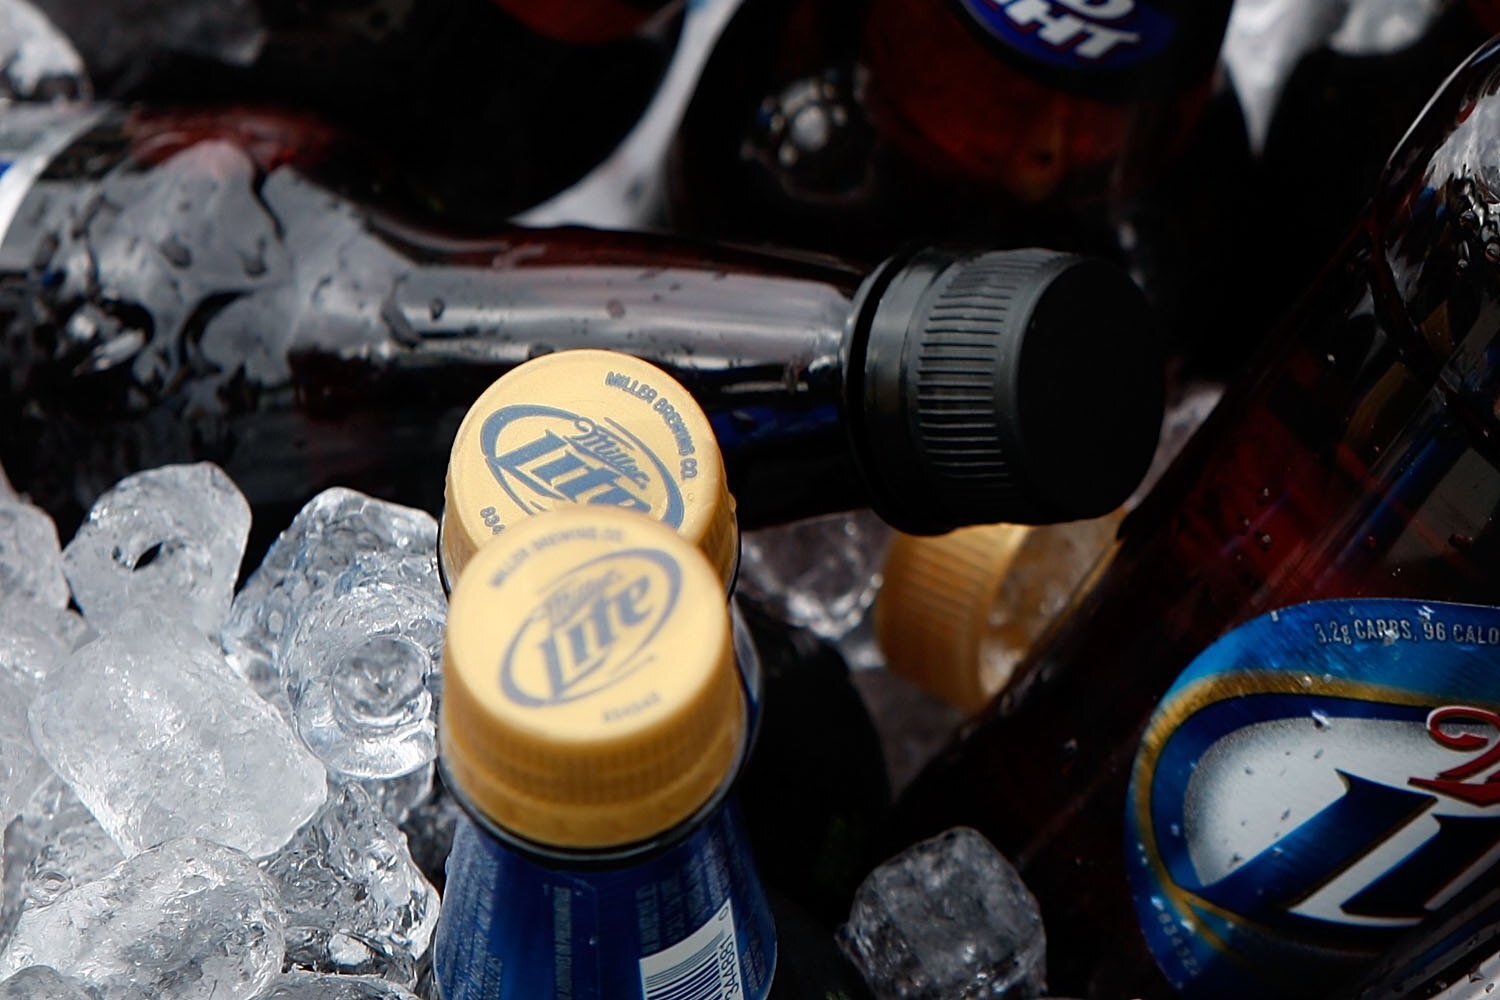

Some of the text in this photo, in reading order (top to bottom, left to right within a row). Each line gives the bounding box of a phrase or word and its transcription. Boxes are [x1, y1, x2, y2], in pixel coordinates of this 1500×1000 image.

[605, 370, 657, 404] MILLER
[654, 397, 695, 457] BREWING
[573, 416, 650, 490] Miller
[480, 506, 506, 536] 834
[538, 574, 651, 701] Lite
[1314, 622, 1352, 645] 3.2g
[1354, 618, 1418, 645] CARBS,
[1423, 619, 1447, 641] 96
